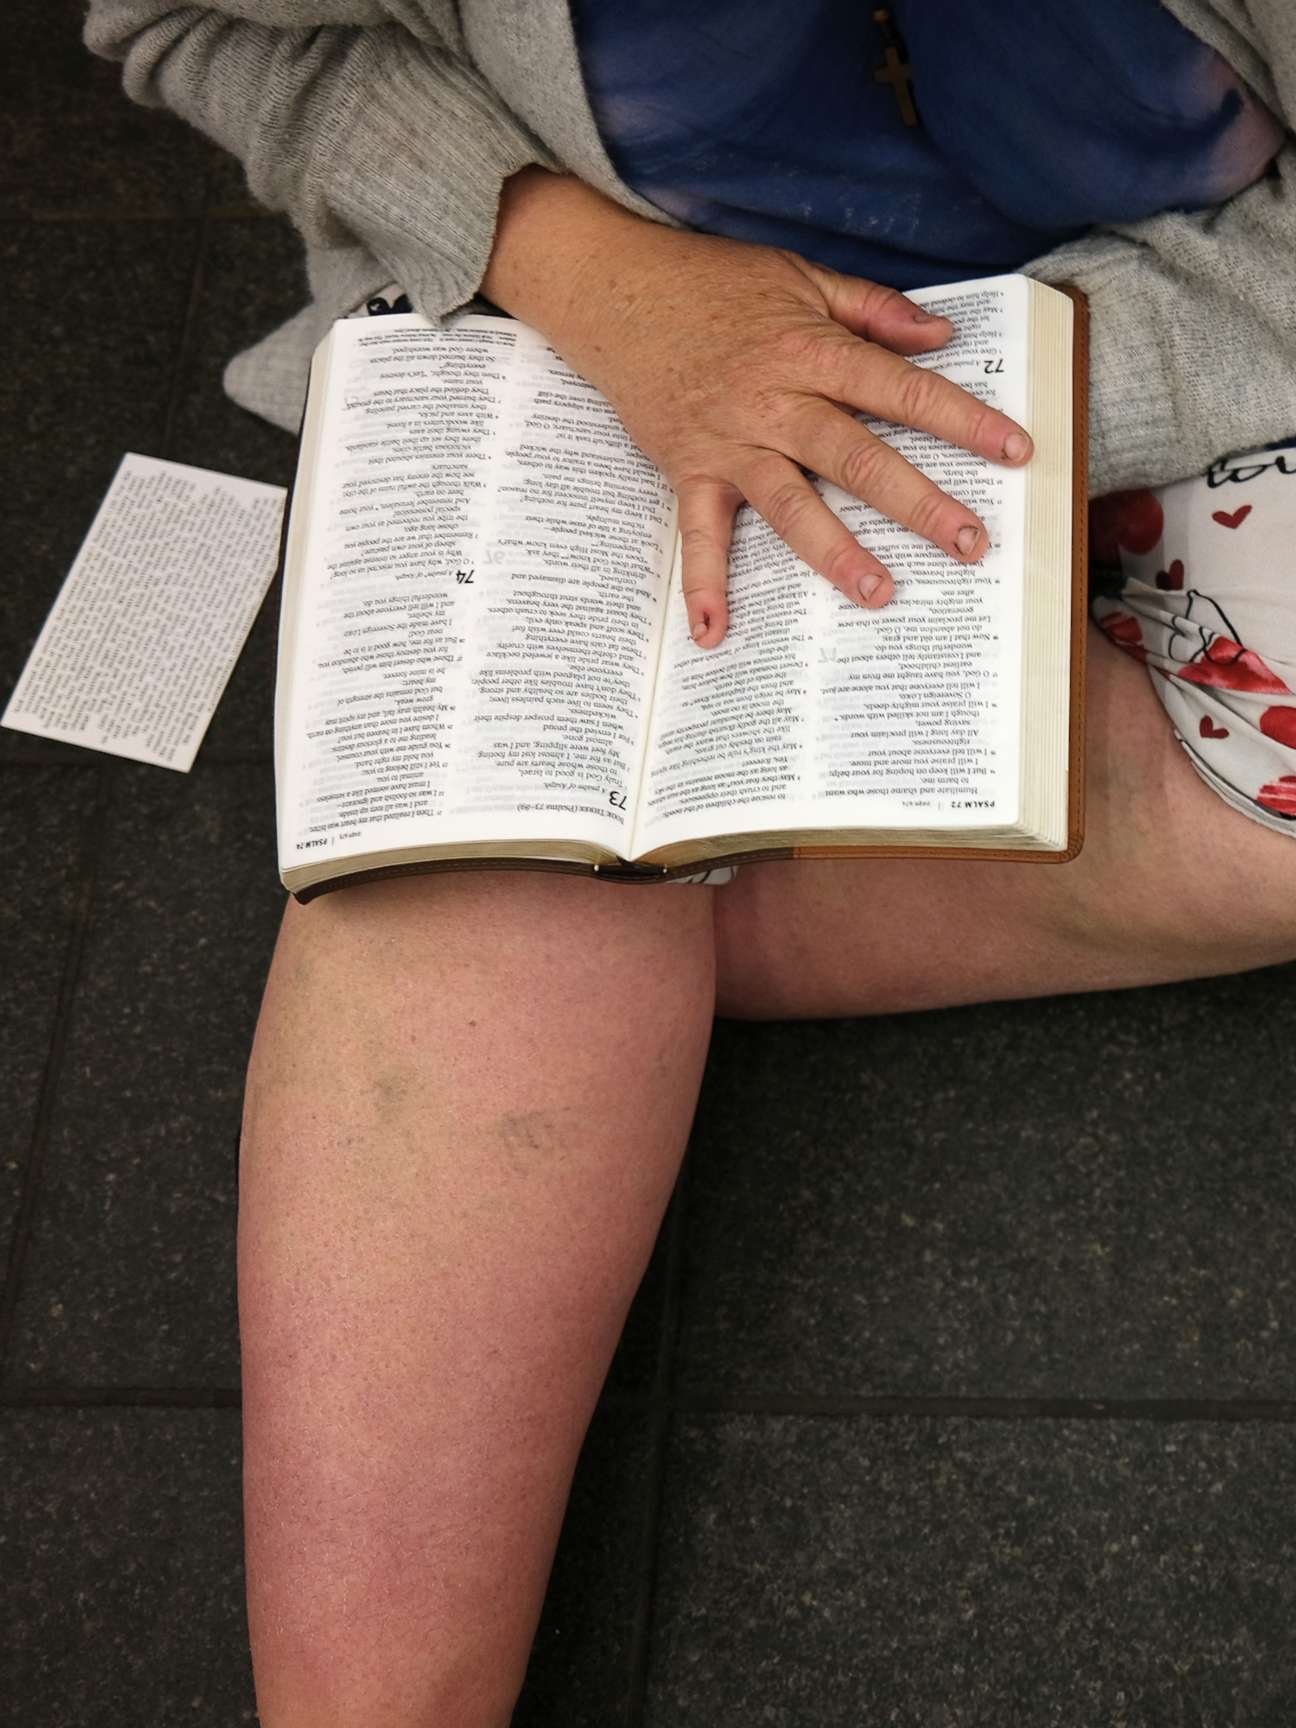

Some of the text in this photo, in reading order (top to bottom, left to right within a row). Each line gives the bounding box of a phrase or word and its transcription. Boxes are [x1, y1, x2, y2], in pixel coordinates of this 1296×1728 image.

[984, 359, 1005, 374] 72
[456, 570, 474, 584] 74
[609, 791, 628, 810] 73
[306, 838, 328, 848] PSALM
